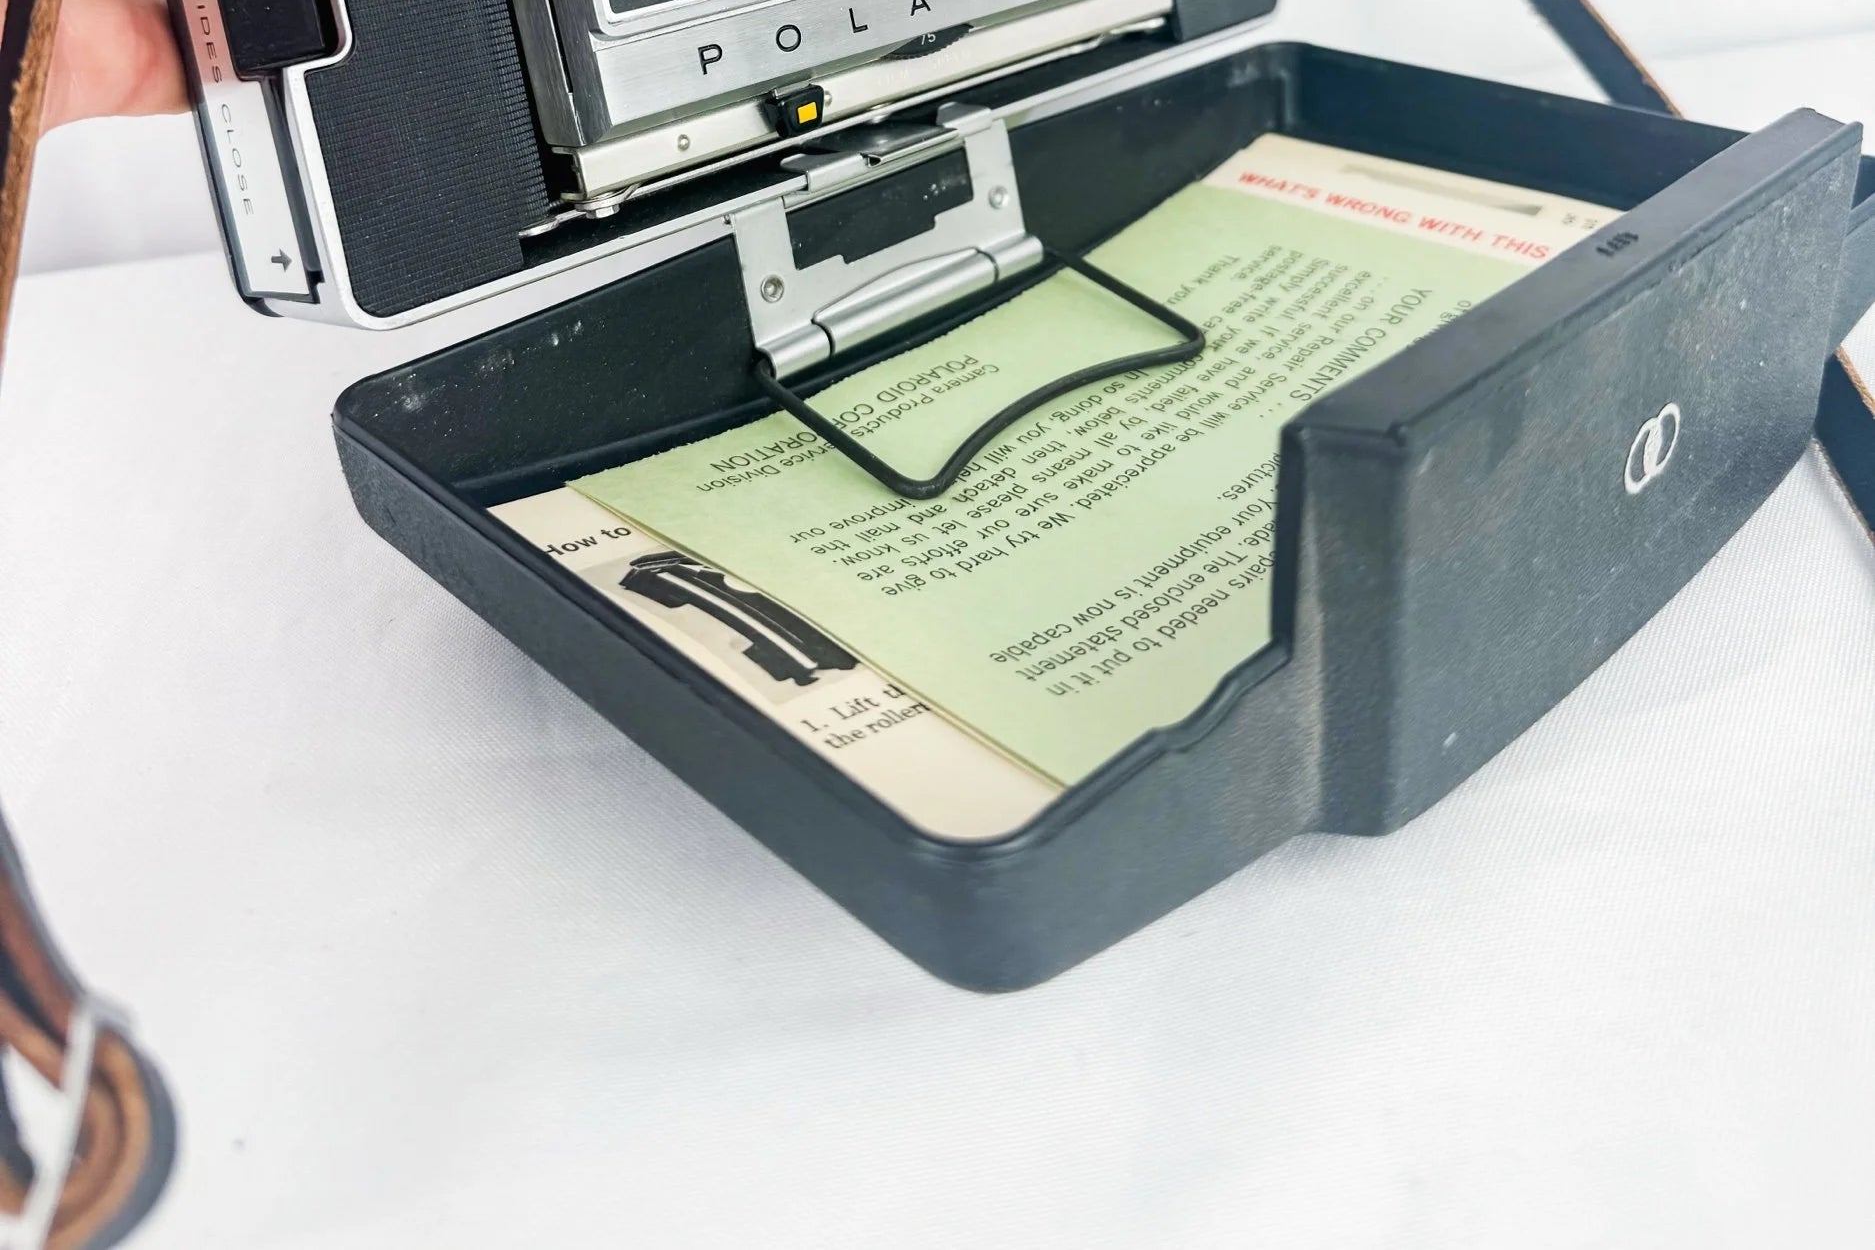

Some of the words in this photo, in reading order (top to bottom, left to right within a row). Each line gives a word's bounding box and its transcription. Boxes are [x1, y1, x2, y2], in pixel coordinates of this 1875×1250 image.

[221, 103, 254, 216] CLOSE
[1239, 172, 1320, 198] WHAT'S
[1325, 191, 1412, 223] WRONG
[1418, 215, 1484, 243] WITH
[1492, 234, 1550, 259] THIS
[1241, 295, 1280, 324] write
[1378, 287, 1433, 326] YOUR
[1258, 324, 1281, 338] If
[1328, 312, 1356, 335] our
[1234, 337, 1261, 355] we
[1254, 321, 1313, 361] service,
[1281, 334, 1336, 372] Repair
[1195, 356, 1241, 382] have
[1288, 326, 1387, 402] COMMENTS
[875, 353, 979, 403] POLAROID
[929, 363, 1000, 395] Camera
[1101, 380, 1126, 394] so
[1222, 365, 1257, 390] and
[1142, 383, 1200, 413] failed,
[1226, 371, 1288, 411] Service
[849, 392, 935, 438] Products
[1047, 393, 1103, 423] doing,
[1173, 390, 1225, 421] would
[1015, 420, 1052, 445] you
[1065, 405, 1127, 437] below,
[1118, 415, 1149, 431] by
[1139, 420, 1178, 441] like
[1197, 410, 1230, 429] will
[1092, 430, 1118, 448] all
[1174, 426, 1205, 443] be
[982, 443, 1017, 465] will
[1020, 439, 1068, 465] then
[1115, 443, 1142, 456] to
[694, 463, 782, 492] Division
[1030, 446, 1093, 483] means
[1062, 458, 1115, 490] make
[1068, 442, 1176, 509] appreciated.
[950, 466, 1017, 503] detach
[965, 481, 1029, 519] please
[1013, 491, 1059, 517] sure
[1230, 497, 1280, 527] Your
[827, 497, 916, 530] improve
[905, 503, 948, 526] and
[1036, 510, 1076, 530] We
[600, 526, 632, 539] to
[788, 526, 826, 544] our
[853, 521, 902, 543] mail
[899, 531, 930, 546] us
[930, 518, 968, 536] let
[975, 518, 1010, 540] our
[1004, 529, 1041, 549] try
[809, 538, 852, 555] the
[831, 542, 901, 566] know.
[899, 538, 969, 567] efforts
[953, 545, 1010, 573] hard
[1131, 524, 1232, 589] equipment
[855, 563, 895, 581] are
[928, 566, 958, 580] to
[1201, 549, 1249, 574] The
[879, 572, 927, 596] give
[1113, 585, 1144, 600] is
[1071, 597, 1117, 627] now
[1118, 572, 1206, 630] enclosed
[1155, 587, 1231, 640] needed
[988, 622, 1073, 663] capable
[1014, 624, 1124, 682] statement
[1131, 636, 1163, 652] to
[1089, 647, 1134, 676] put
[1044, 680, 1080, 697] in
[1069, 670, 1100, 686] it
[830, 697, 880, 720] Lift
[824, 728, 866, 749] the
